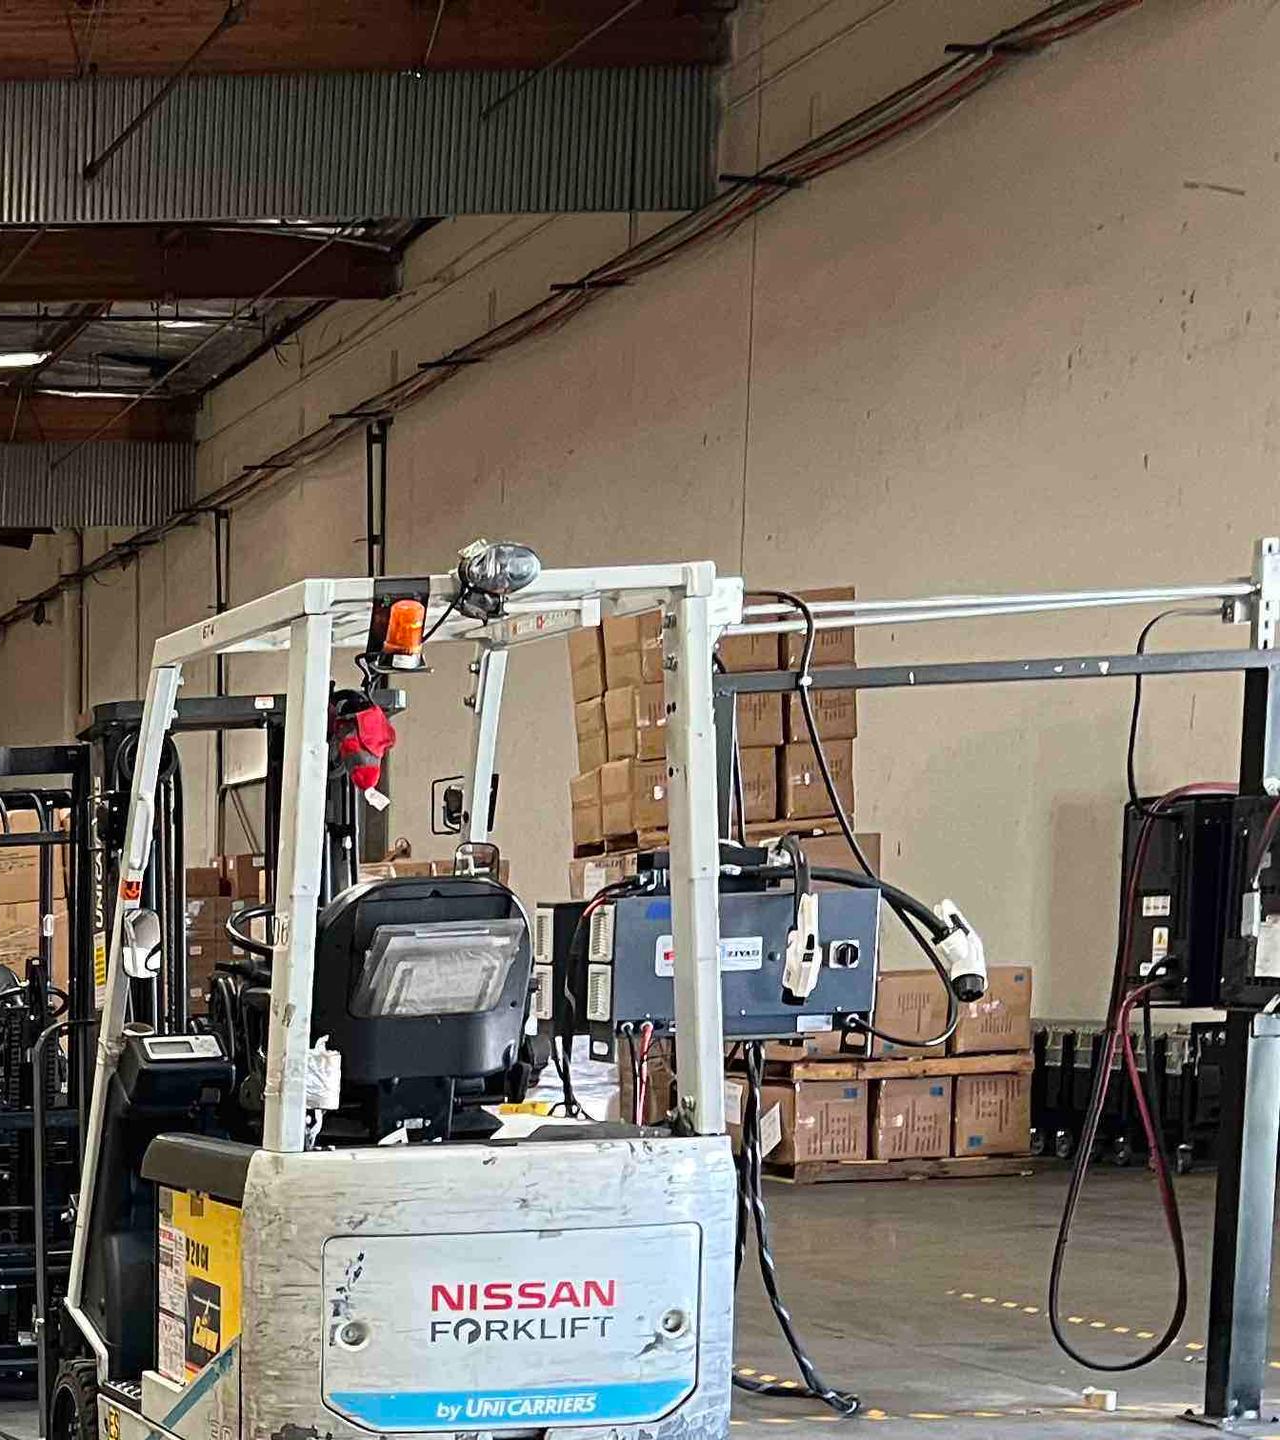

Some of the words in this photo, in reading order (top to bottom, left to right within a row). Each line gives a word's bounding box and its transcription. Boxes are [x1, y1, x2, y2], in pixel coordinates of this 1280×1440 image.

[431, 1279, 616, 1312] NISSAN
[430, 1316, 614, 1345] FORKLIFT
[436, 1402, 463, 1421] by
